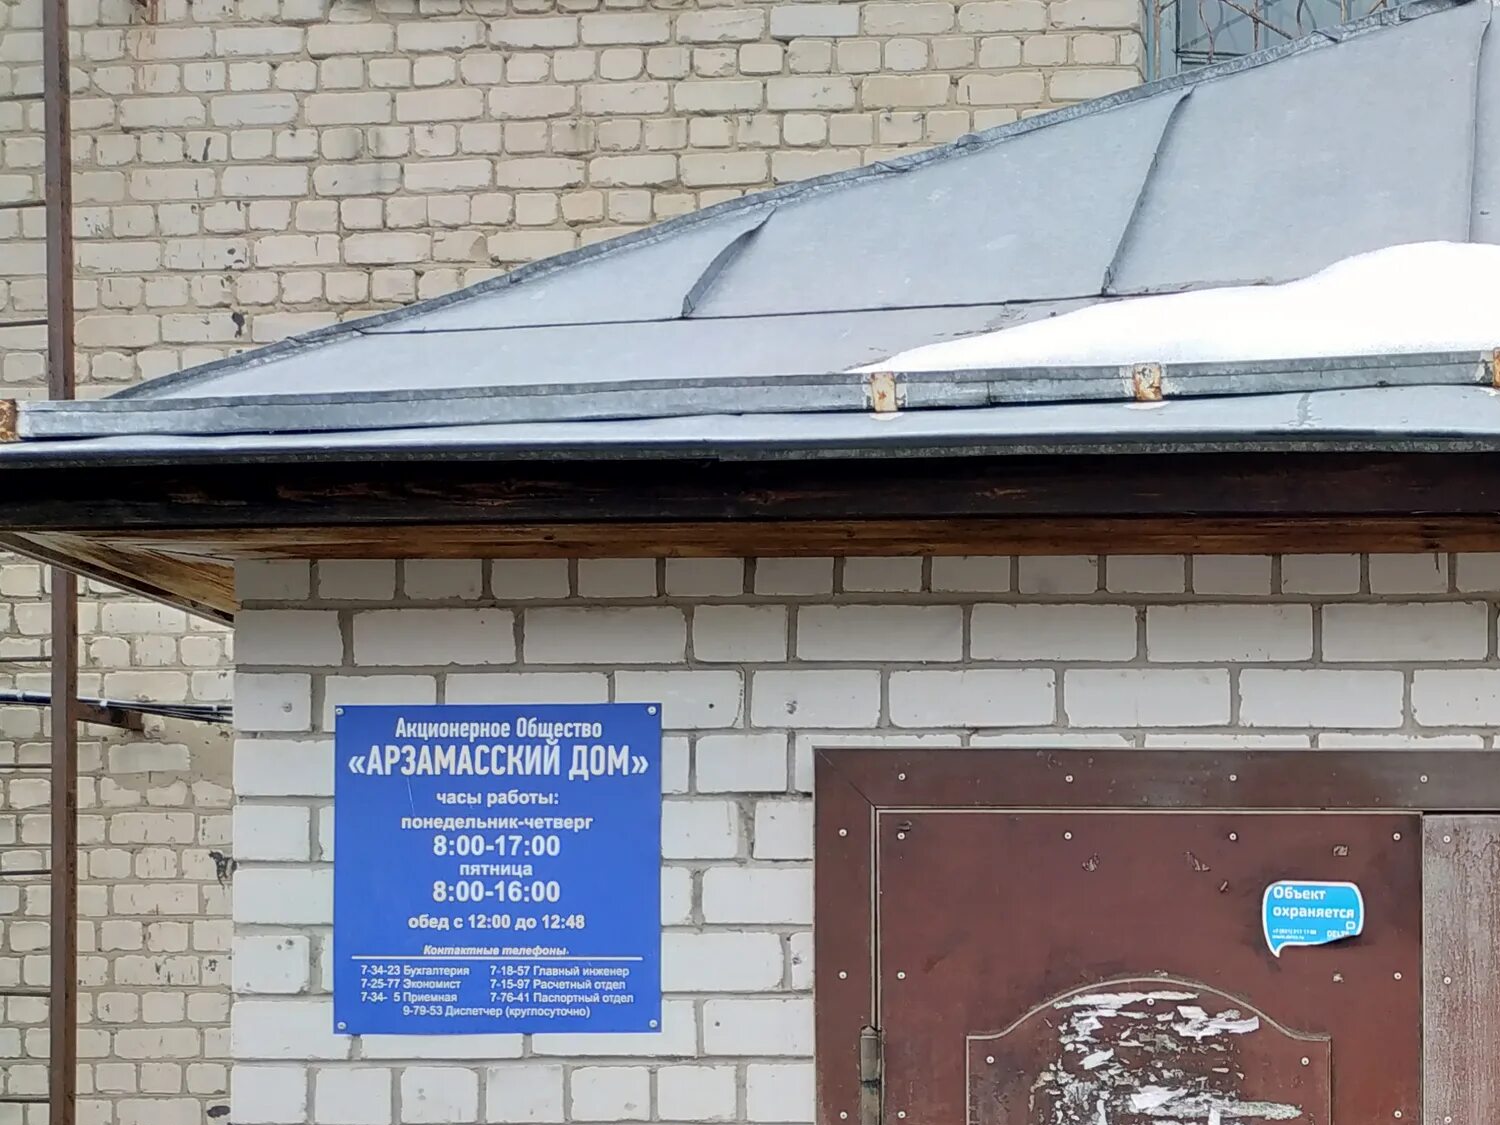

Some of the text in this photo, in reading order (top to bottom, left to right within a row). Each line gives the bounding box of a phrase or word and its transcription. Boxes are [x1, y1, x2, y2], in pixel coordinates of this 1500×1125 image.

[395, 717, 602, 742] Акционерное Общество
[348, 738, 649, 781] «АРЗАМАССКИЙ ДОМ»
[436, 789, 559, 808] часы работы:
[401, 817, 594, 832] понедельник-четверг
[433, 835, 561, 856] 8:00-17:00
[460, 864, 533, 878] пятница
[432, 880, 561, 902] 8:00-16:00
[1273, 886, 1326, 900] Объект
[1272, 906, 1355, 919] охраняется
[408, 913, 585, 931] обед с 12:00 до 12:48
[423, 944, 500, 956] Контактные
[361, 965, 470, 978] 7-34-23 Бухгалтерия
[490, 965, 630, 979] 7-18-57 Главный инженер
[361, 979, 461, 990] 7-25-77 Экономист
[490, 979, 626, 992] 7-15-97 Расчетный отдел
[403, 992, 458, 1005] Приемная
[490, 992, 634, 1005] 7-76-41 Паспортный отдел
[403, 1006, 591, 1019] 9-79-53 Диспетчер (круглосуточно)
